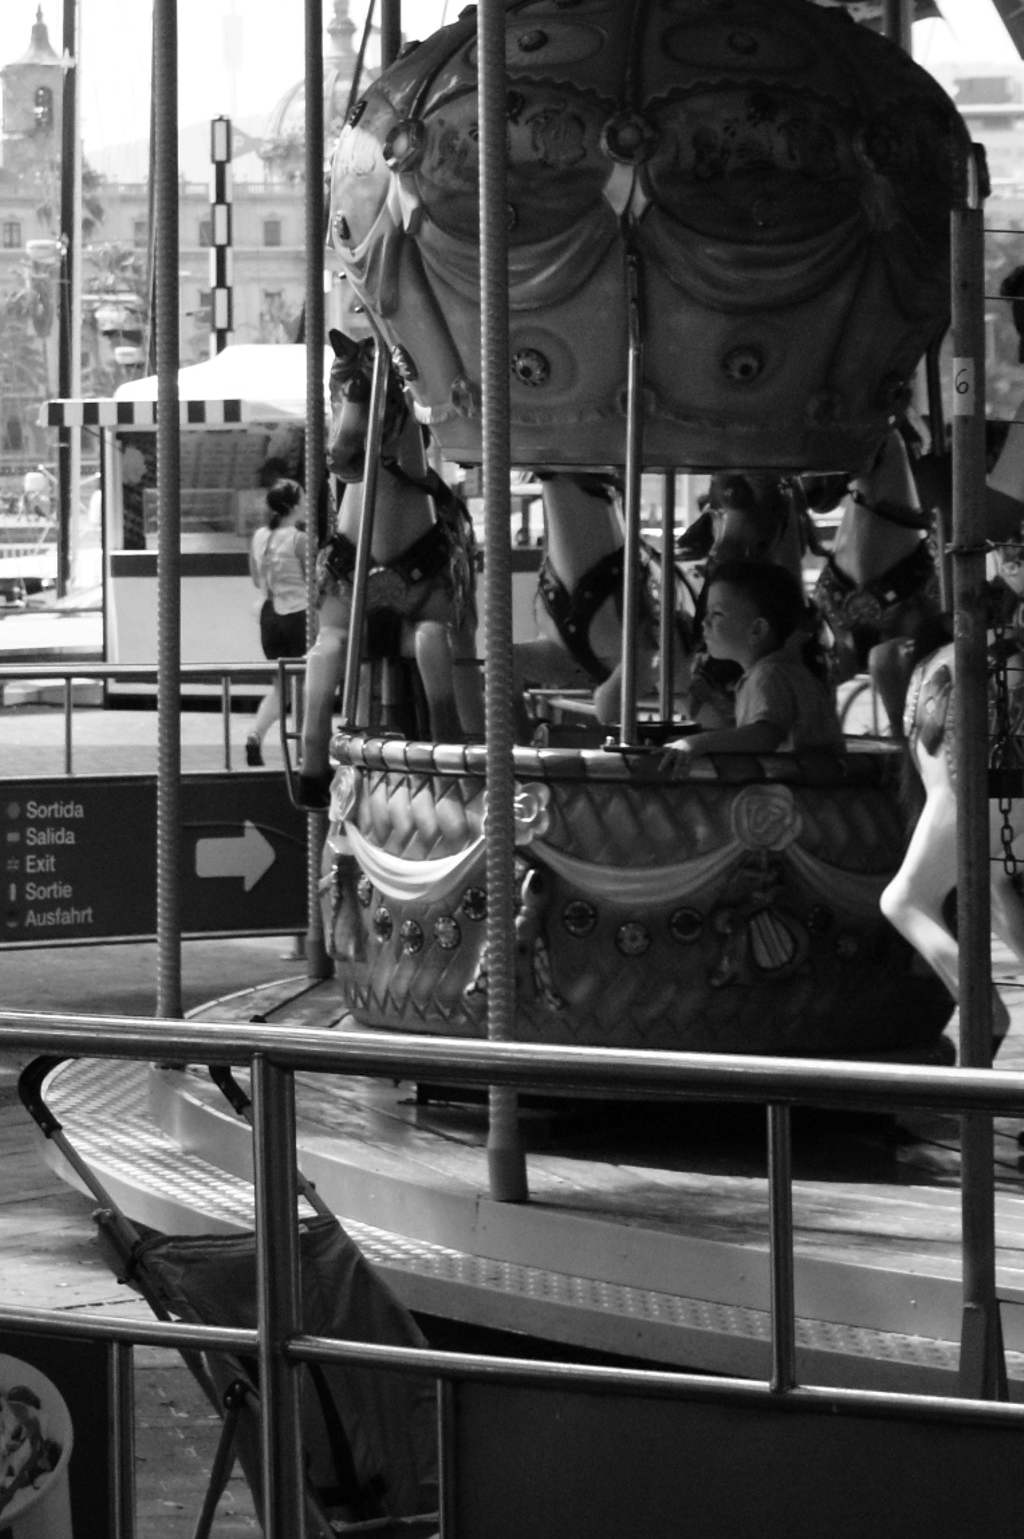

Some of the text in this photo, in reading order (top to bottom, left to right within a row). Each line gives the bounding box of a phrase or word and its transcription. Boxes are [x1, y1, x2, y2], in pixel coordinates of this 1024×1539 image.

[955, 367, 969, 395] 6
[26, 801, 84, 819] Sortida
[26, 827, 75, 846] Salida
[26, 855, 55, 873] Exit
[25, 881, 72, 900] Sortie
[25, 906, 93, 926] Ausfahrt
